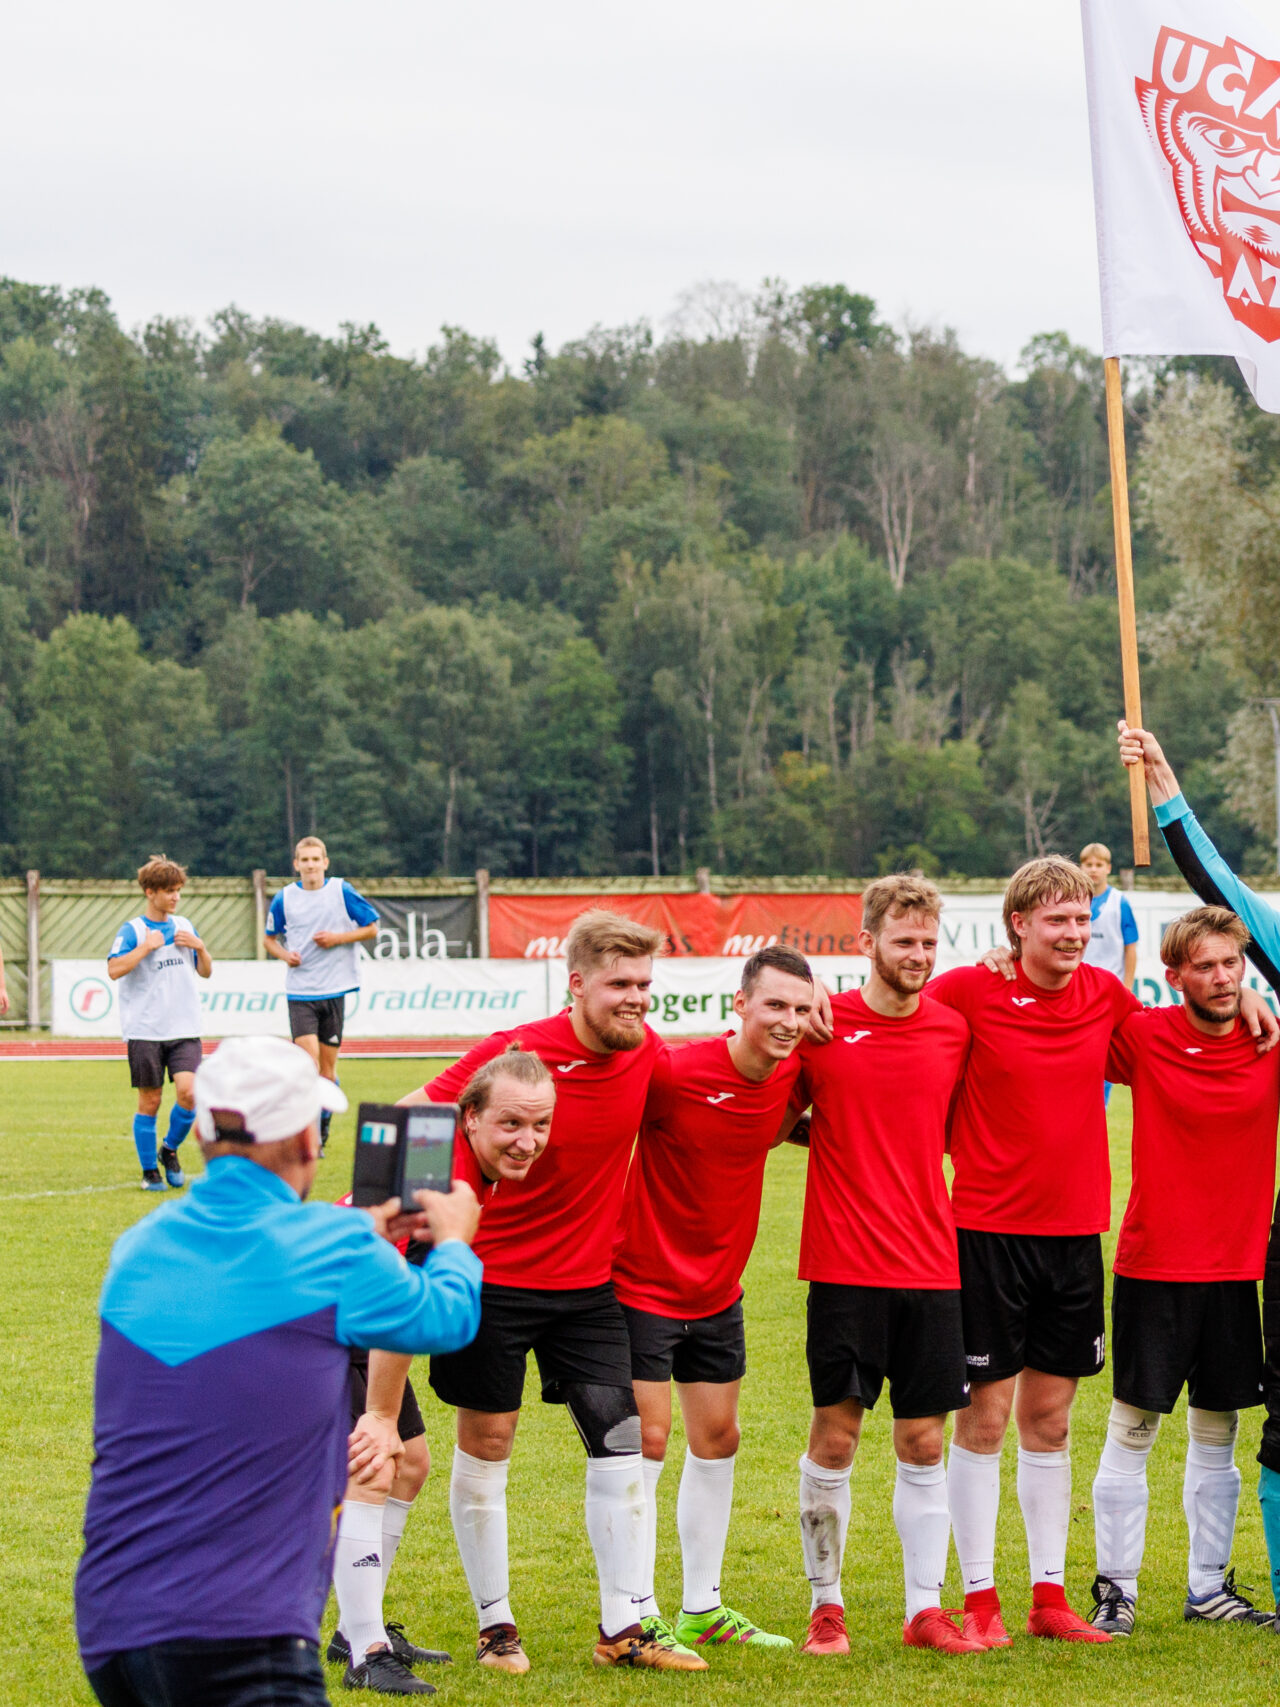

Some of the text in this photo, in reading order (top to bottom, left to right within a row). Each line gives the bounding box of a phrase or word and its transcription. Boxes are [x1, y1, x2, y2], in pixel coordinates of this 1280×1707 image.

[359, 911, 448, 960] ala
[722, 924, 862, 955] myfitne
[368, 984, 528, 1011] rademar
[650, 992, 713, 1022] oger
